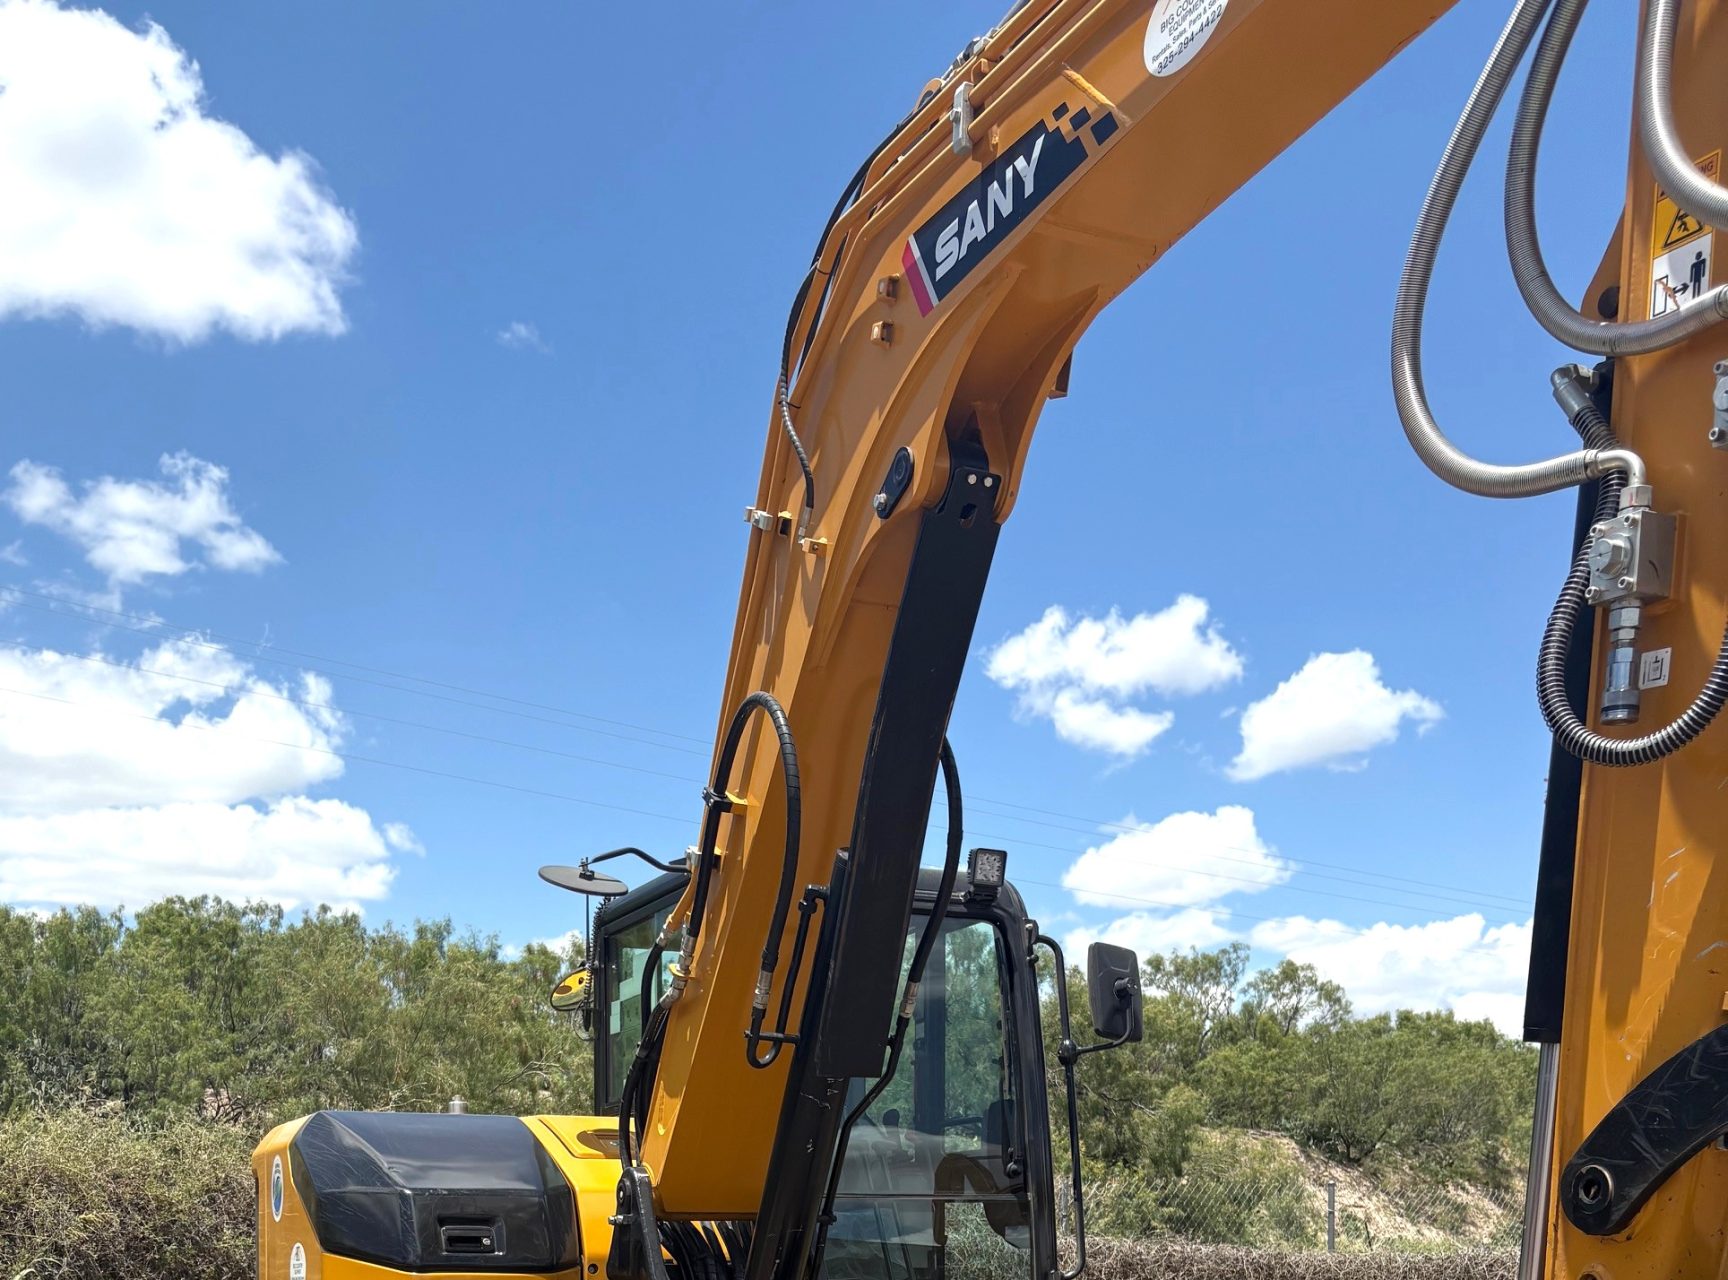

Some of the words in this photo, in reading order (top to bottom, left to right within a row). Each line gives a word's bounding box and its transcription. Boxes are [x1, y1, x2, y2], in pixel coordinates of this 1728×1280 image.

[1157, 4, 1222, 74] 325-294-4422
[1161, 14, 1175, 33] BIG
[1189, 12, 1202, 29] Parts
[935, 133, 1045, 282] SANY
